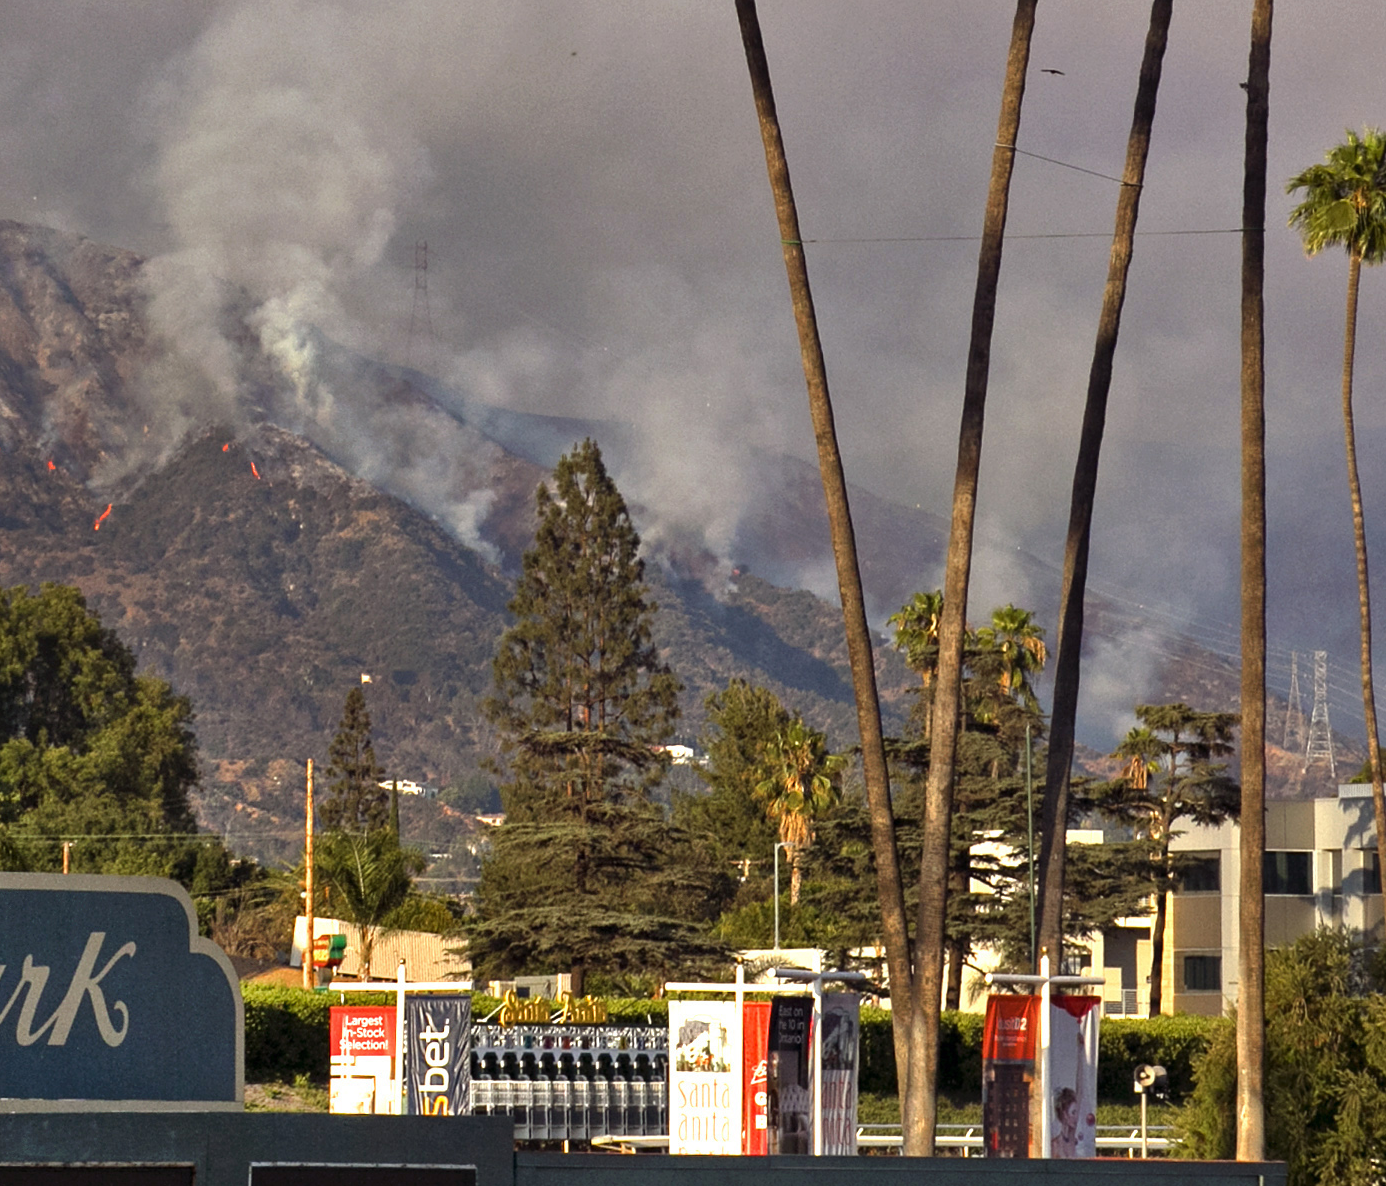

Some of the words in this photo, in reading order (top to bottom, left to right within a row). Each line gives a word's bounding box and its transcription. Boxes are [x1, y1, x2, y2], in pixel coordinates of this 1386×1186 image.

[793, 1007, 804, 1017] on
[345, 1015, 383, 1027] Largest
[343, 1027, 385, 1038] In-Stock
[339, 1039, 389, 1050] Selection!
[821, 1078, 852, 1110] anta
[678, 1111, 731, 1142] anita
[822, 1114, 852, 1146] nita
